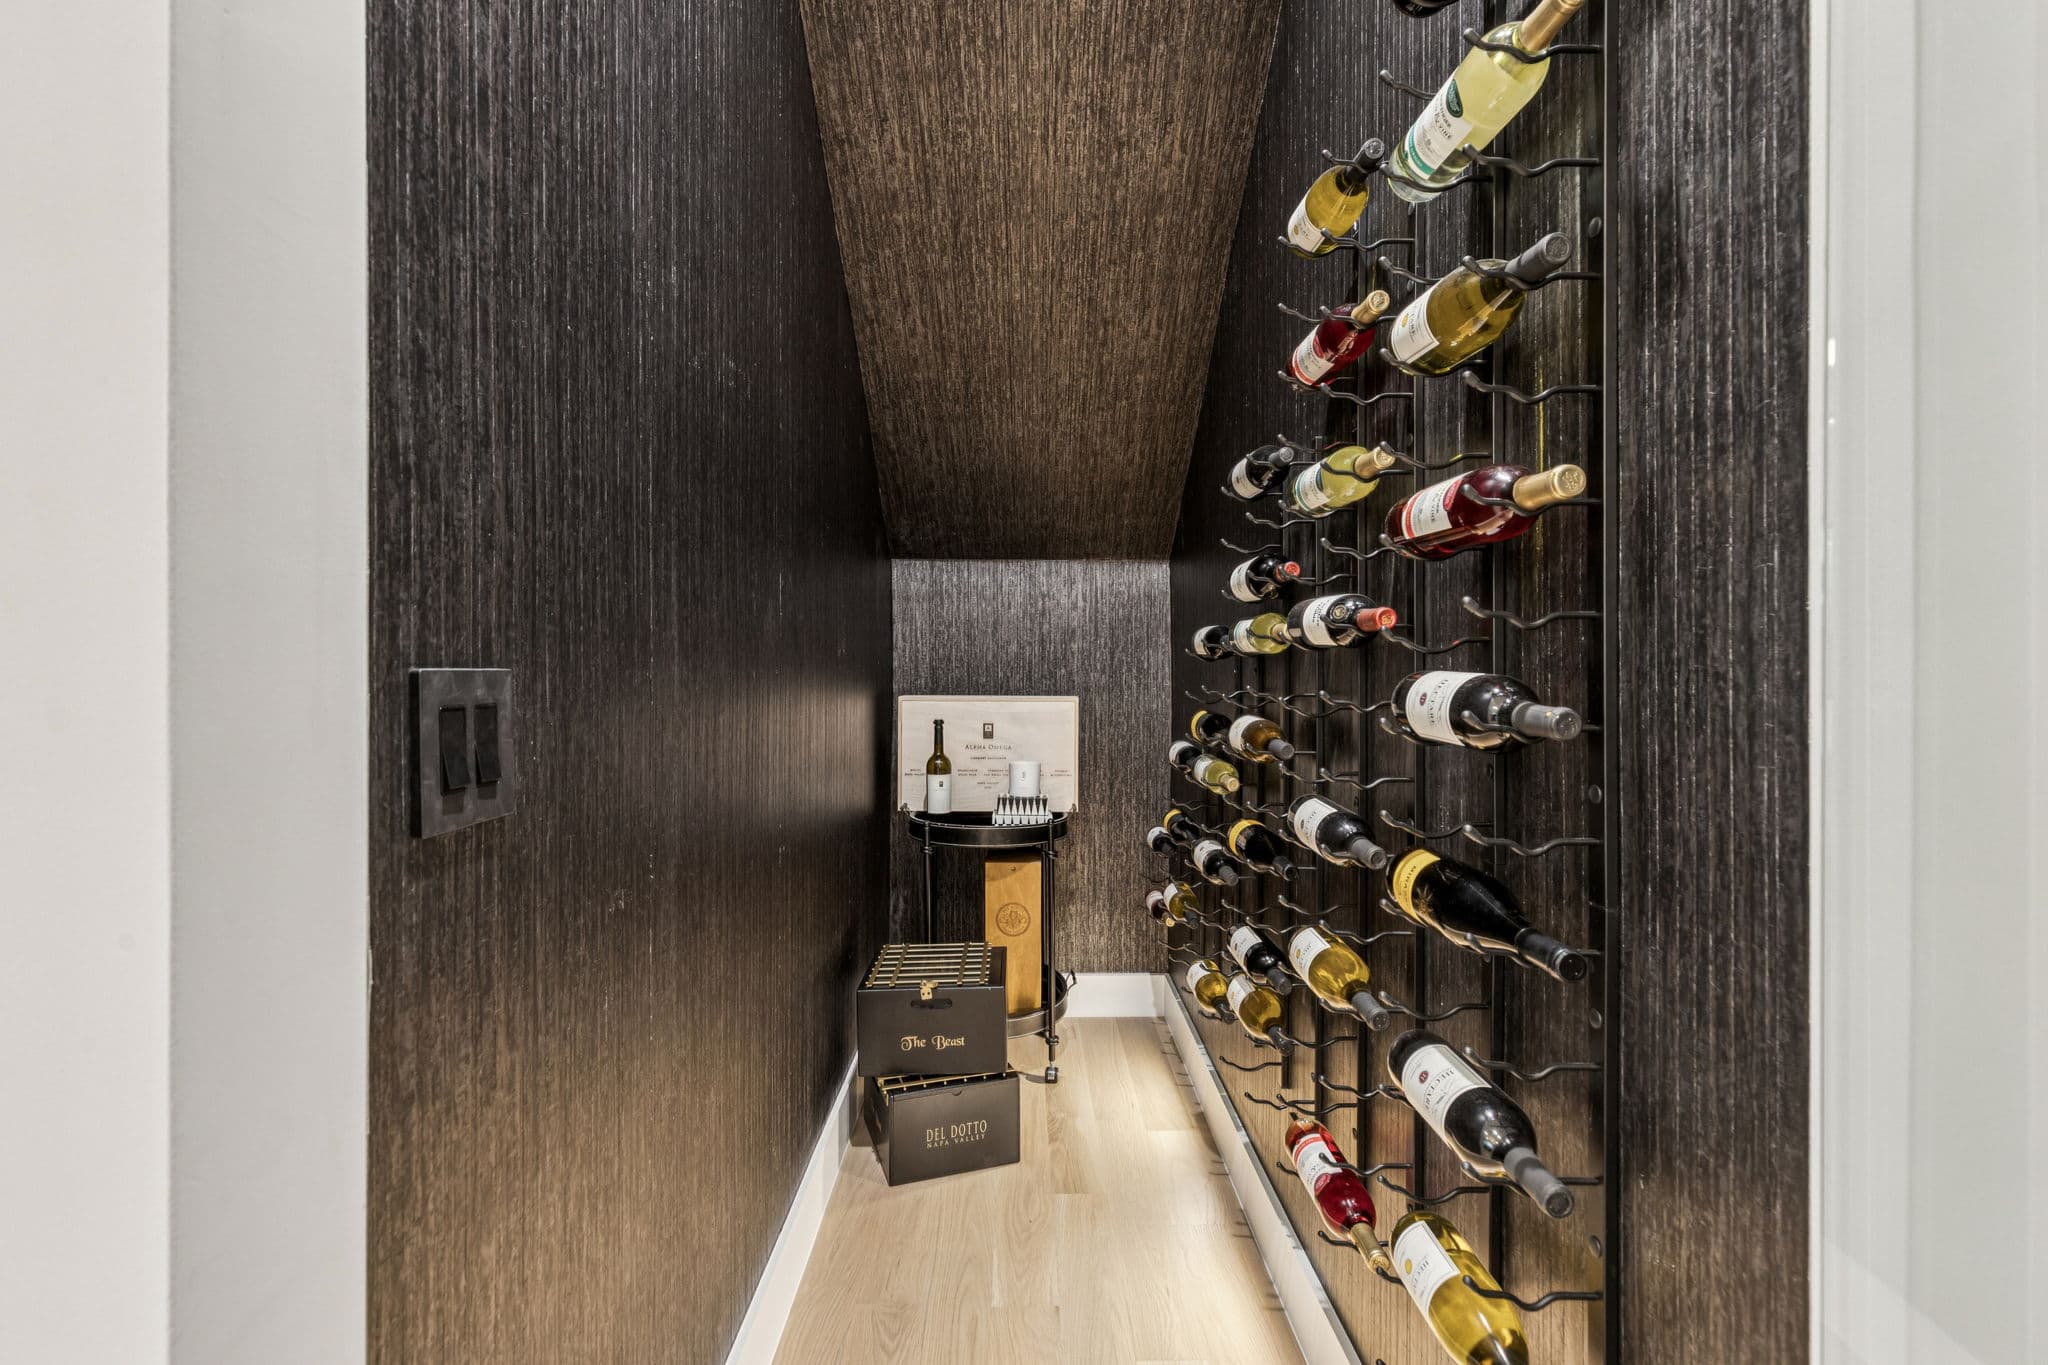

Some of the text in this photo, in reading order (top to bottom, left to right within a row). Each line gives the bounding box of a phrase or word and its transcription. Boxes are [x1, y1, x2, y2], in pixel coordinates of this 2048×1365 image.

[900, 1035, 966, 1051] The Beast
[926, 1119, 988, 1142] DEL DOTTO
[926, 1133, 986, 1150] NAPA VALLEY
